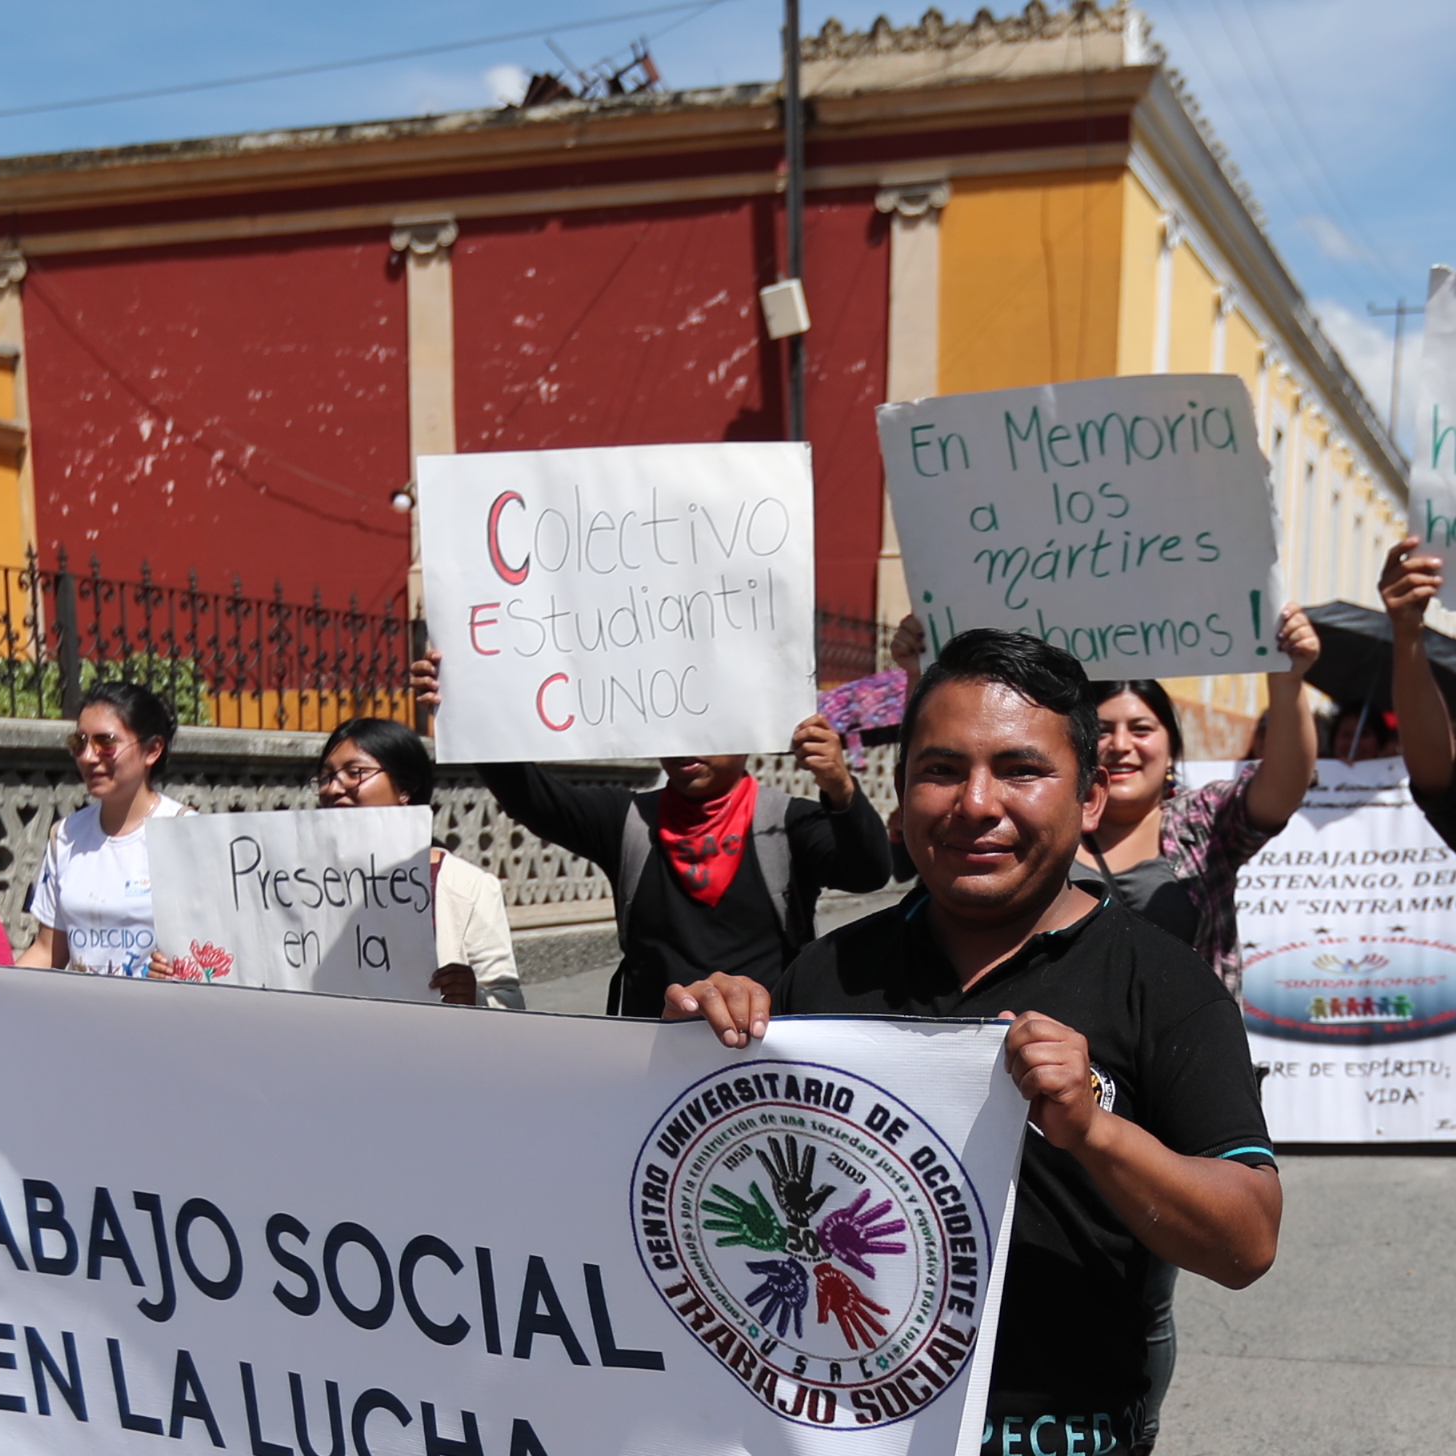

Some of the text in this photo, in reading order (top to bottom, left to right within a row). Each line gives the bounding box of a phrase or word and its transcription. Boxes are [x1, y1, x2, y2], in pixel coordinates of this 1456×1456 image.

[910, 401, 1238, 478] En Memoria
[486, 484, 791, 586] Colectivo
[970, 482, 1130, 532] a los
[974, 529, 1221, 610] mártires
[535, 665, 709, 732] CUNOC
[229, 835, 431, 913] Presentes
[1246, 846, 1450, 869] RABAJADORES
[90, 928, 154, 950] DECIDO
[283, 924, 391, 973] en la
[1309, 1061, 1337, 1078] DE
[656, 1072, 855, 1160] UNIVERSITARIO
[864, 1102, 910, 1146] DE
[640, 1163, 678, 1271] CENTRO
[909, 1144, 978, 1319] OCCIDENTE
[265, 1212, 666, 1371] SOCIAL
[663, 1273, 977, 1424] TRABAJO SOCIAL
[106, 1336, 226, 1449] LA
